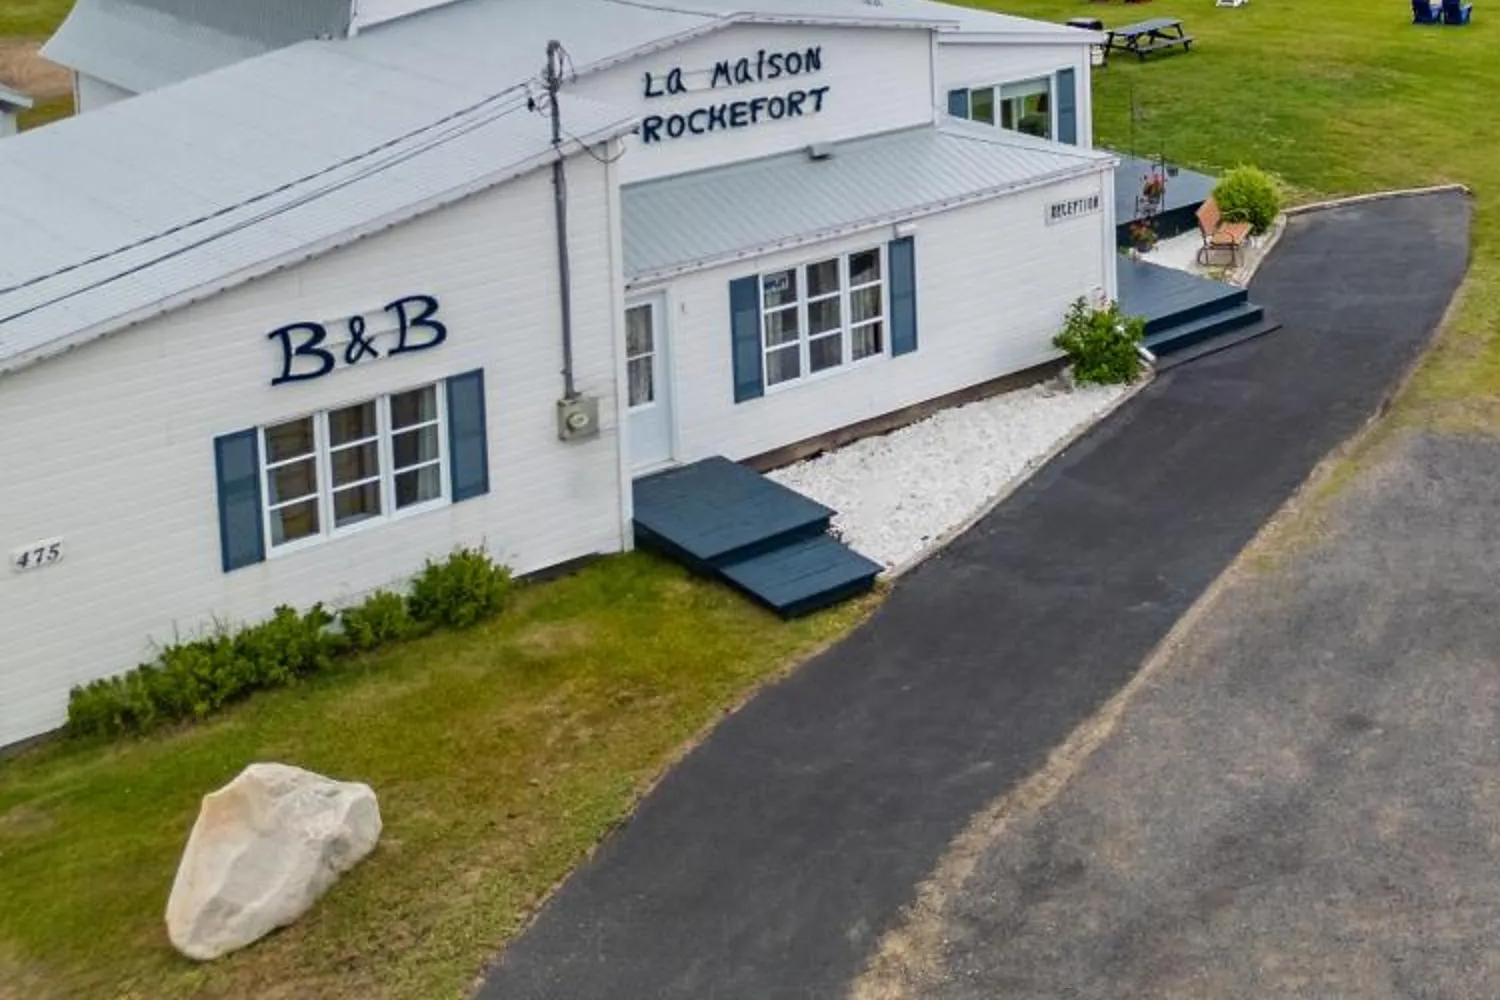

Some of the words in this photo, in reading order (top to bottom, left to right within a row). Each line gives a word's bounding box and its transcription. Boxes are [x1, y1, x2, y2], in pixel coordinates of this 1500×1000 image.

[642, 86, 830, 144] ROCHEFORT
[267, 295, 448, 386] B&B
[16, 542, 61, 569] 475
